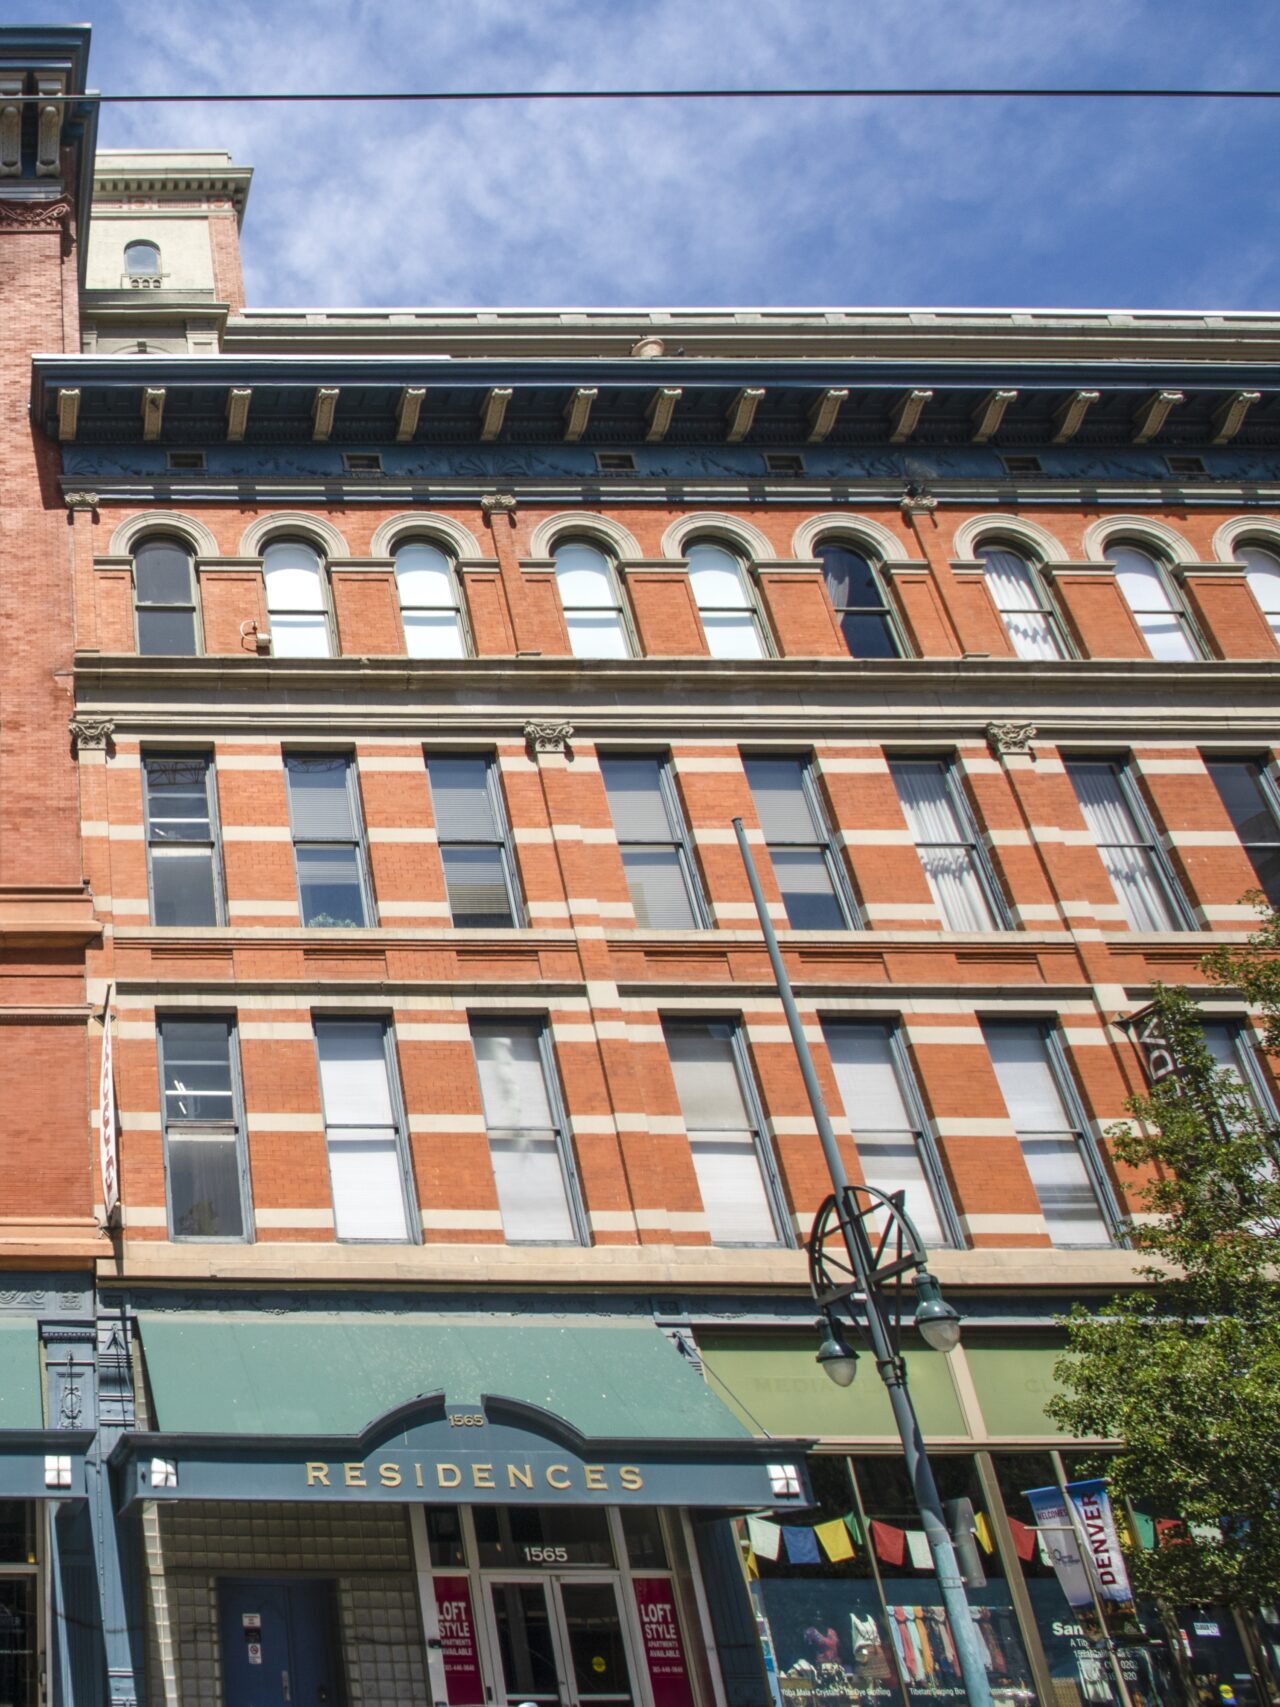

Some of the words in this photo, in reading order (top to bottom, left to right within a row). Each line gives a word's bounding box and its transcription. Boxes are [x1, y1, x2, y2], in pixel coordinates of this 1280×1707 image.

[448, 1413, 484, 1428] 1565
[305, 1461, 644, 1491] RESIDENCES
[1081, 1490, 1117, 1585] DENVER
[523, 1546, 568, 1562] 1565
[437, 1601, 466, 1620] LOFT
[640, 1604, 672, 1623] LOFT
[439, 1621, 470, 1637] STYLE
[644, 1624, 677, 1639] STYLE
